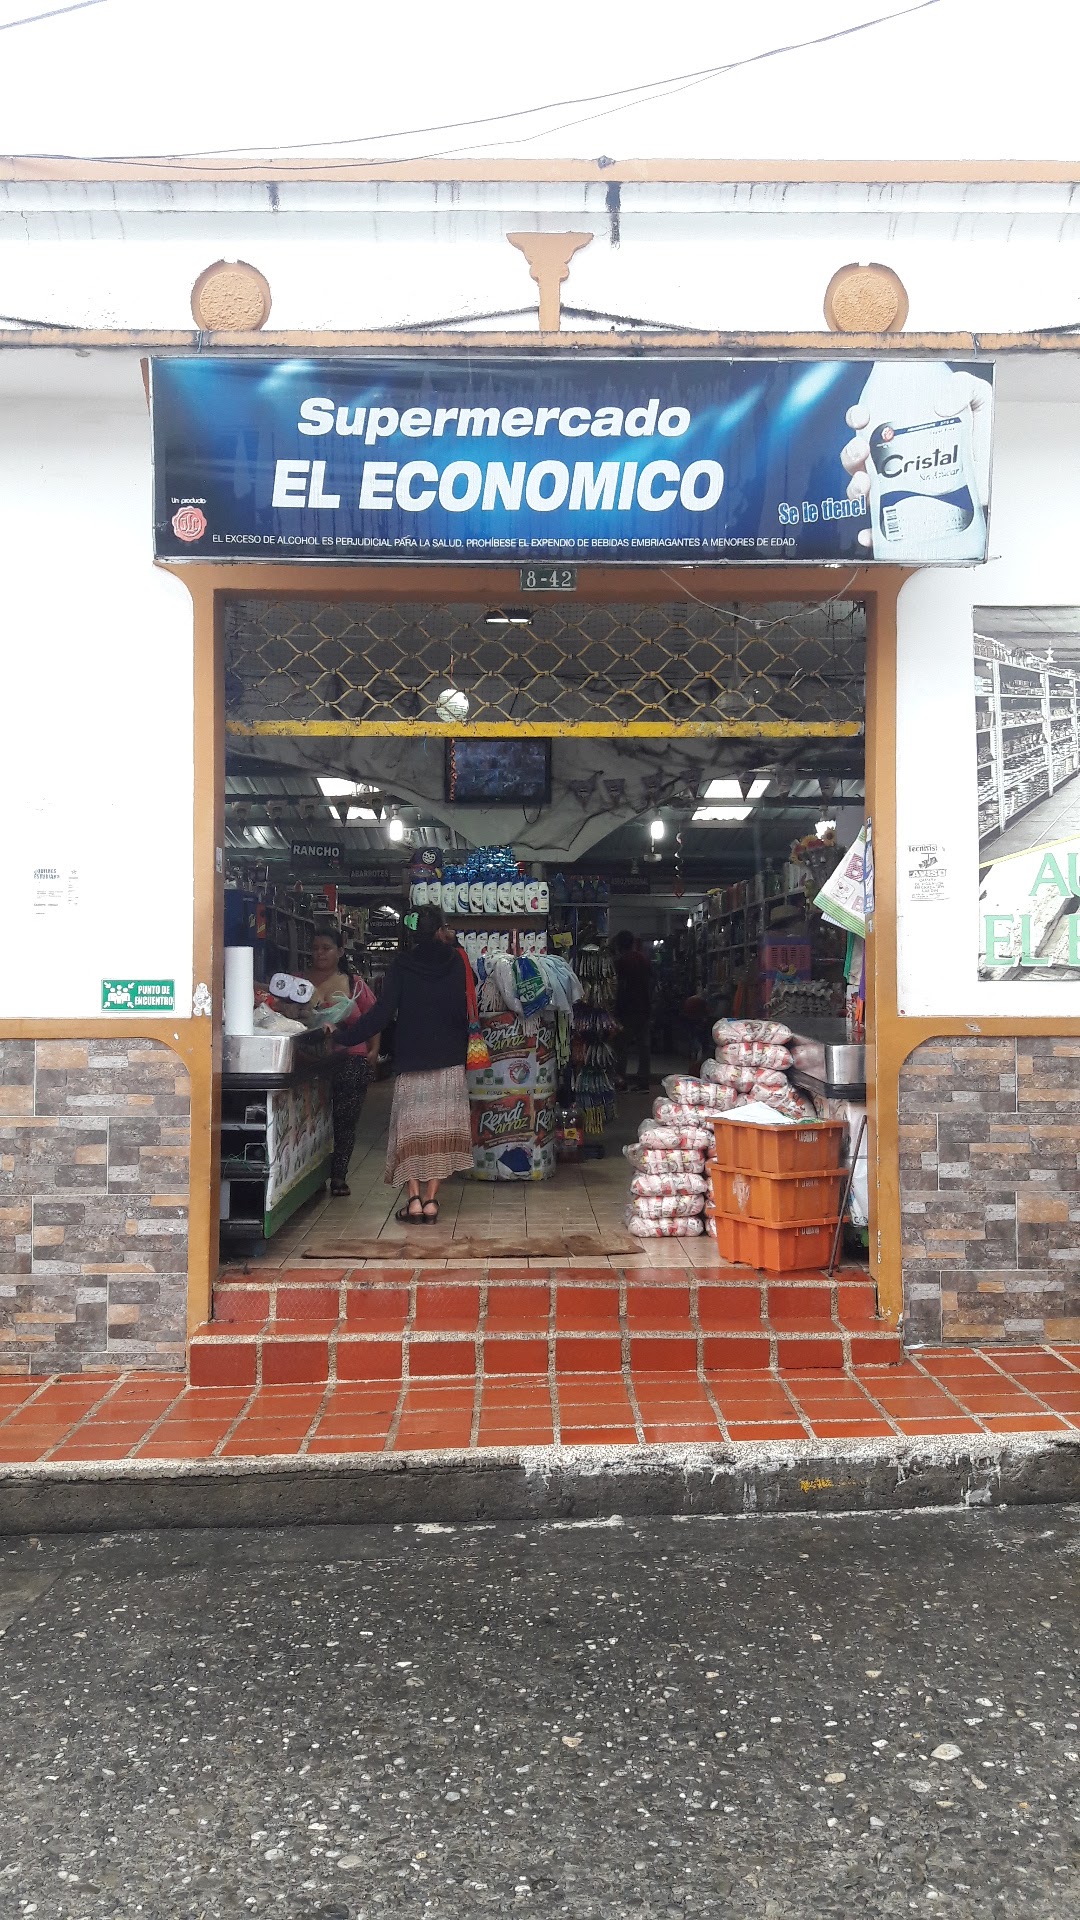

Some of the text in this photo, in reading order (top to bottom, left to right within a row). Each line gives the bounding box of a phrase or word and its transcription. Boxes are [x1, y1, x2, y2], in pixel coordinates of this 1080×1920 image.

[297, 397, 692, 446] Supermercado
[881, 444, 959, 479] Cristal
[271, 459, 725, 512] EL ECONOMICO
[180, 497, 207, 505] producto
[778, 493, 867, 525] Se le tiene!
[212, 534, 224, 543] EL
[225, 534, 262, 544] EXCESO
[263, 535, 276, 544] DE
[277, 536, 320, 546] ALCOHOL
[321, 537, 334, 546] ES
[335, 537, 393, 547] PERJUDICIAL
[394, 538, 418, 547] PARA
[419, 538, 431, 547] LA
[432, 539, 465, 548] SALUD.
[518, 538, 530, 547] EL
[531, 538, 575, 548] EXPENDIO
[577, 538, 590, 547] DE
[591, 538, 630, 547] BEBIDAS
[631, 538, 701, 547] EMBRIAGANTES
[701, 538, 709, 547] A
[710, 538, 755, 547] MENORES
[756, 538, 769, 546] DE
[770, 537, 798, 546] EDAD.
[526, 570, 572, 588] 8-42
[293, 845, 341, 857] RANCHO
[369, 920, 396, 928] VERDURAS
[983, 913, 1051, 967] EL
[137, 985, 171, 995] PUNTO DE
[134, 996, 174, 1006] ENCUENTRO
[492, 1034, 526, 1051] arroz
[479, 1100, 525, 1133] Rendi
[494, 1116, 528, 1134] arroz
